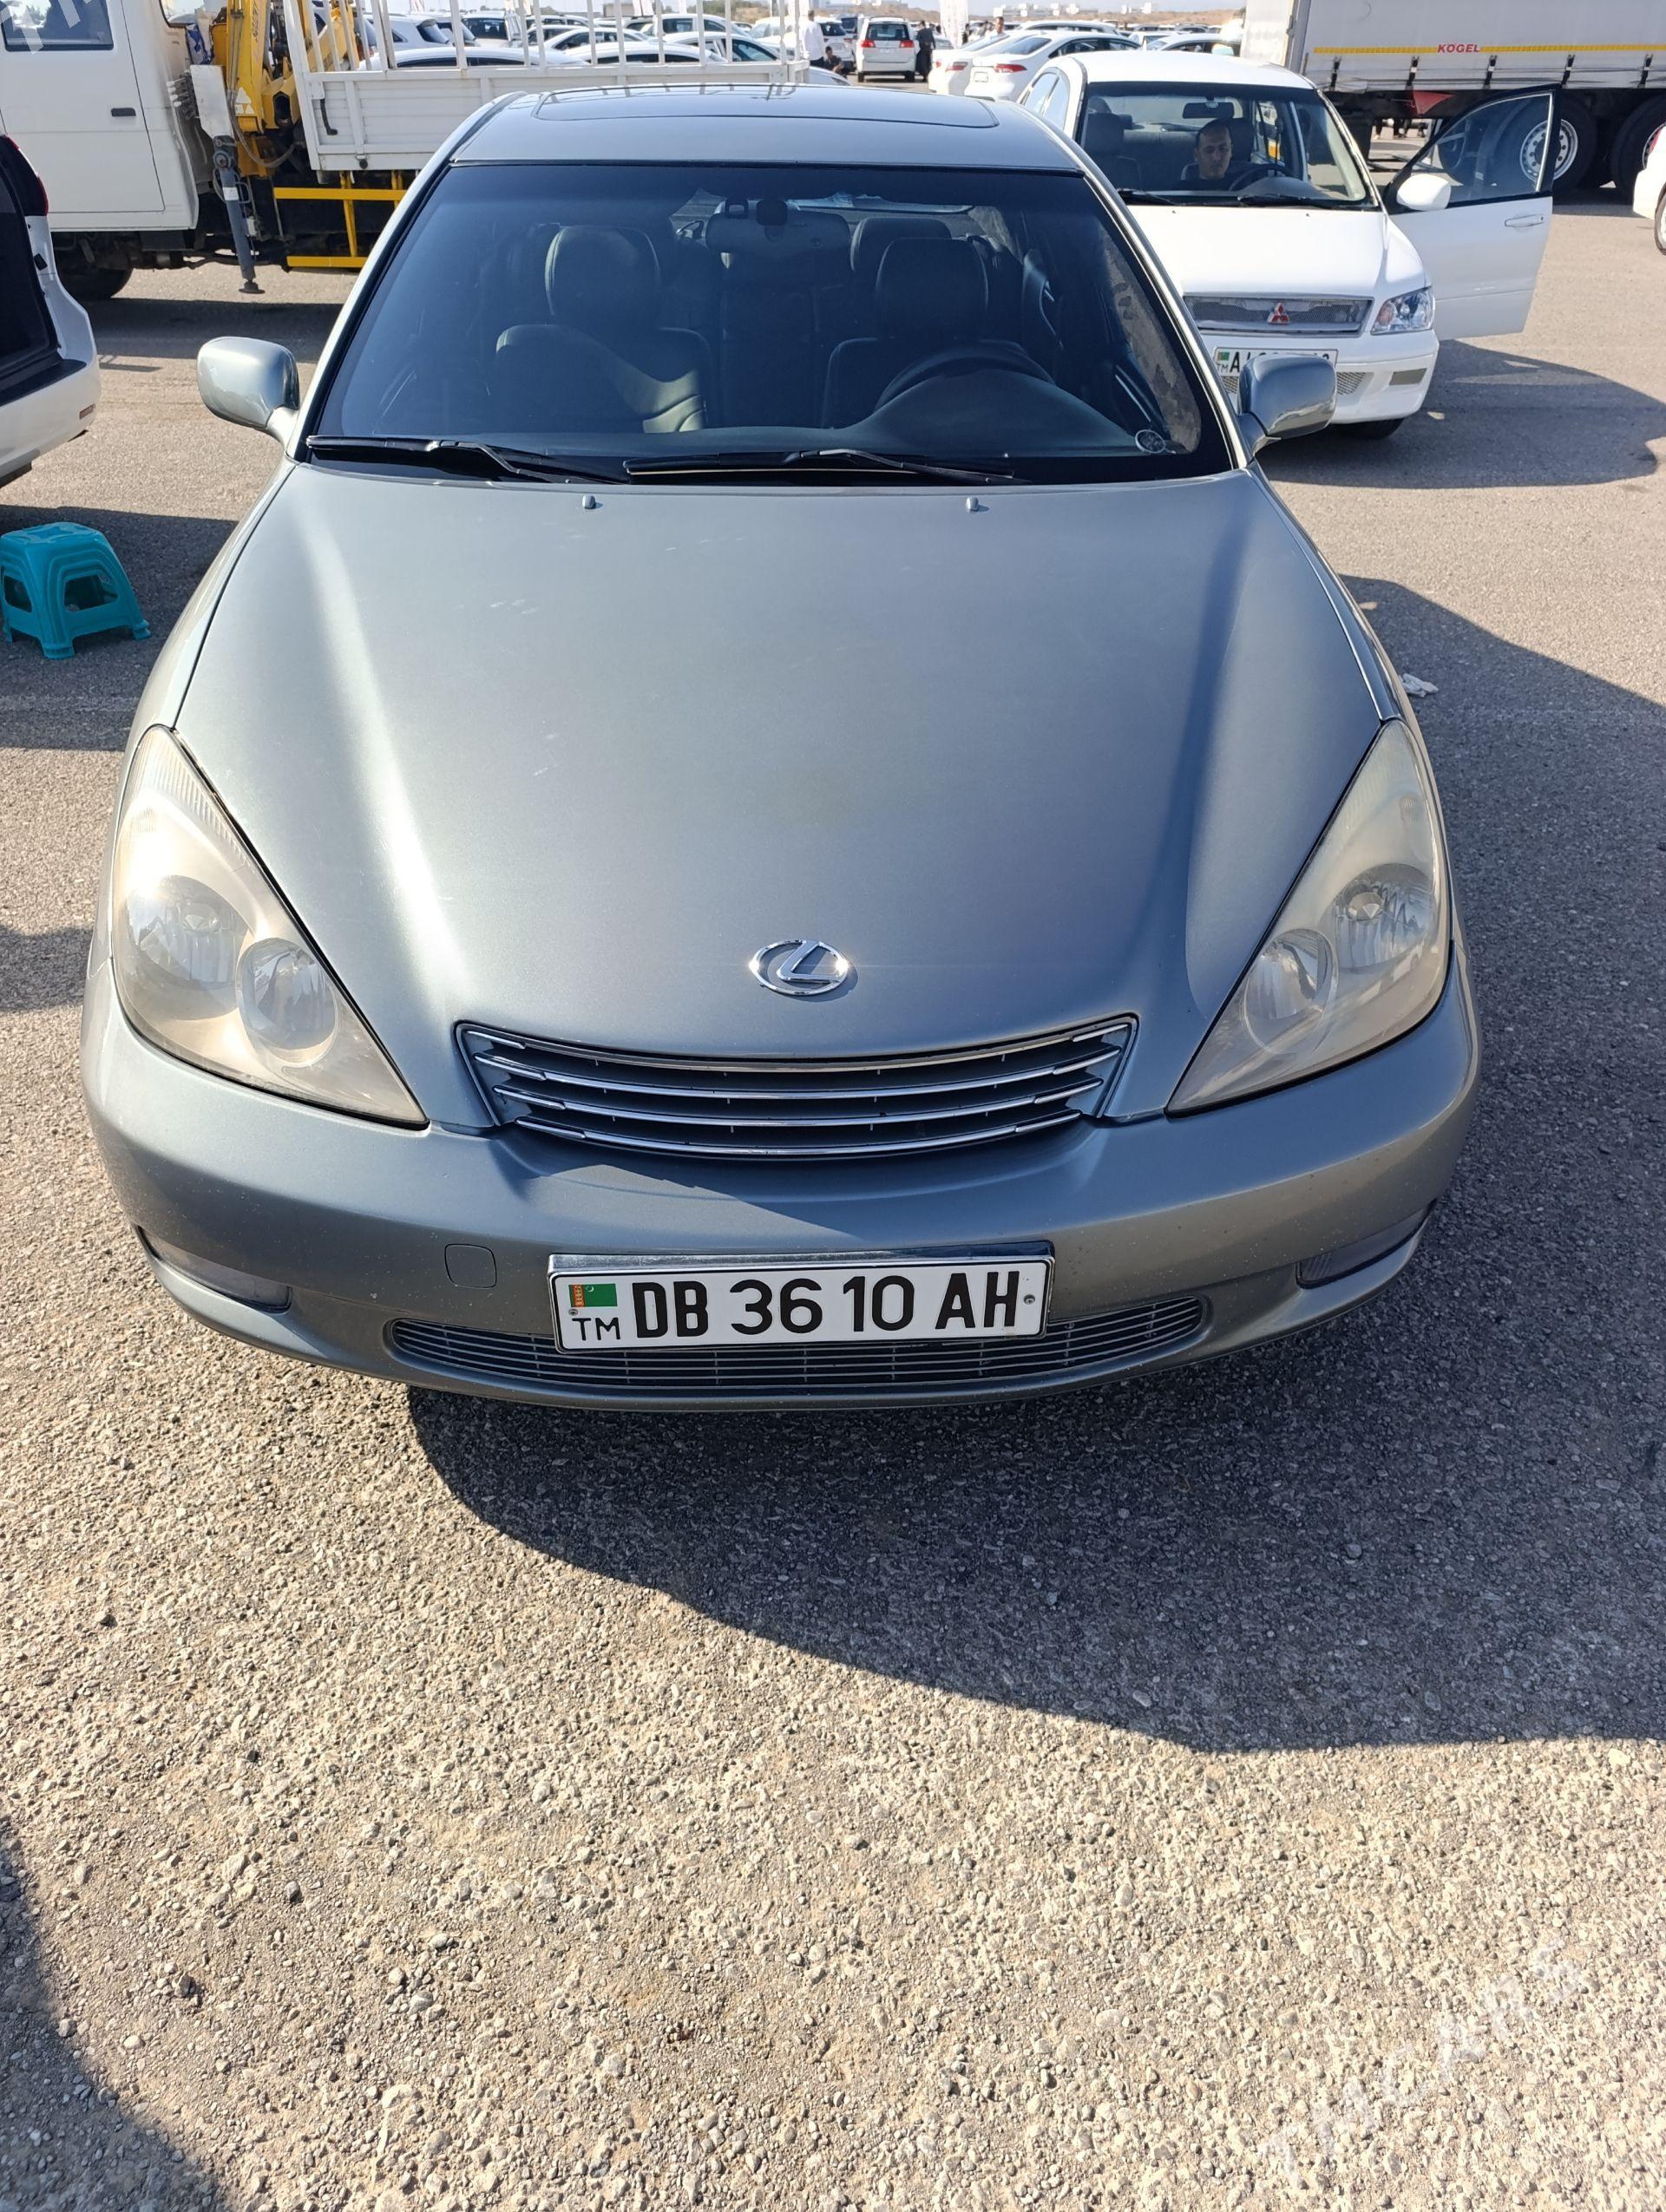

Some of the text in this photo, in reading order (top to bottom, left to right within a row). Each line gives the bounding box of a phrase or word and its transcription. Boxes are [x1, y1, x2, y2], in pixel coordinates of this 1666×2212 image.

[632, 1270, 1020, 1338] DB 36 10 AH
[572, 1317, 621, 1341] TM
